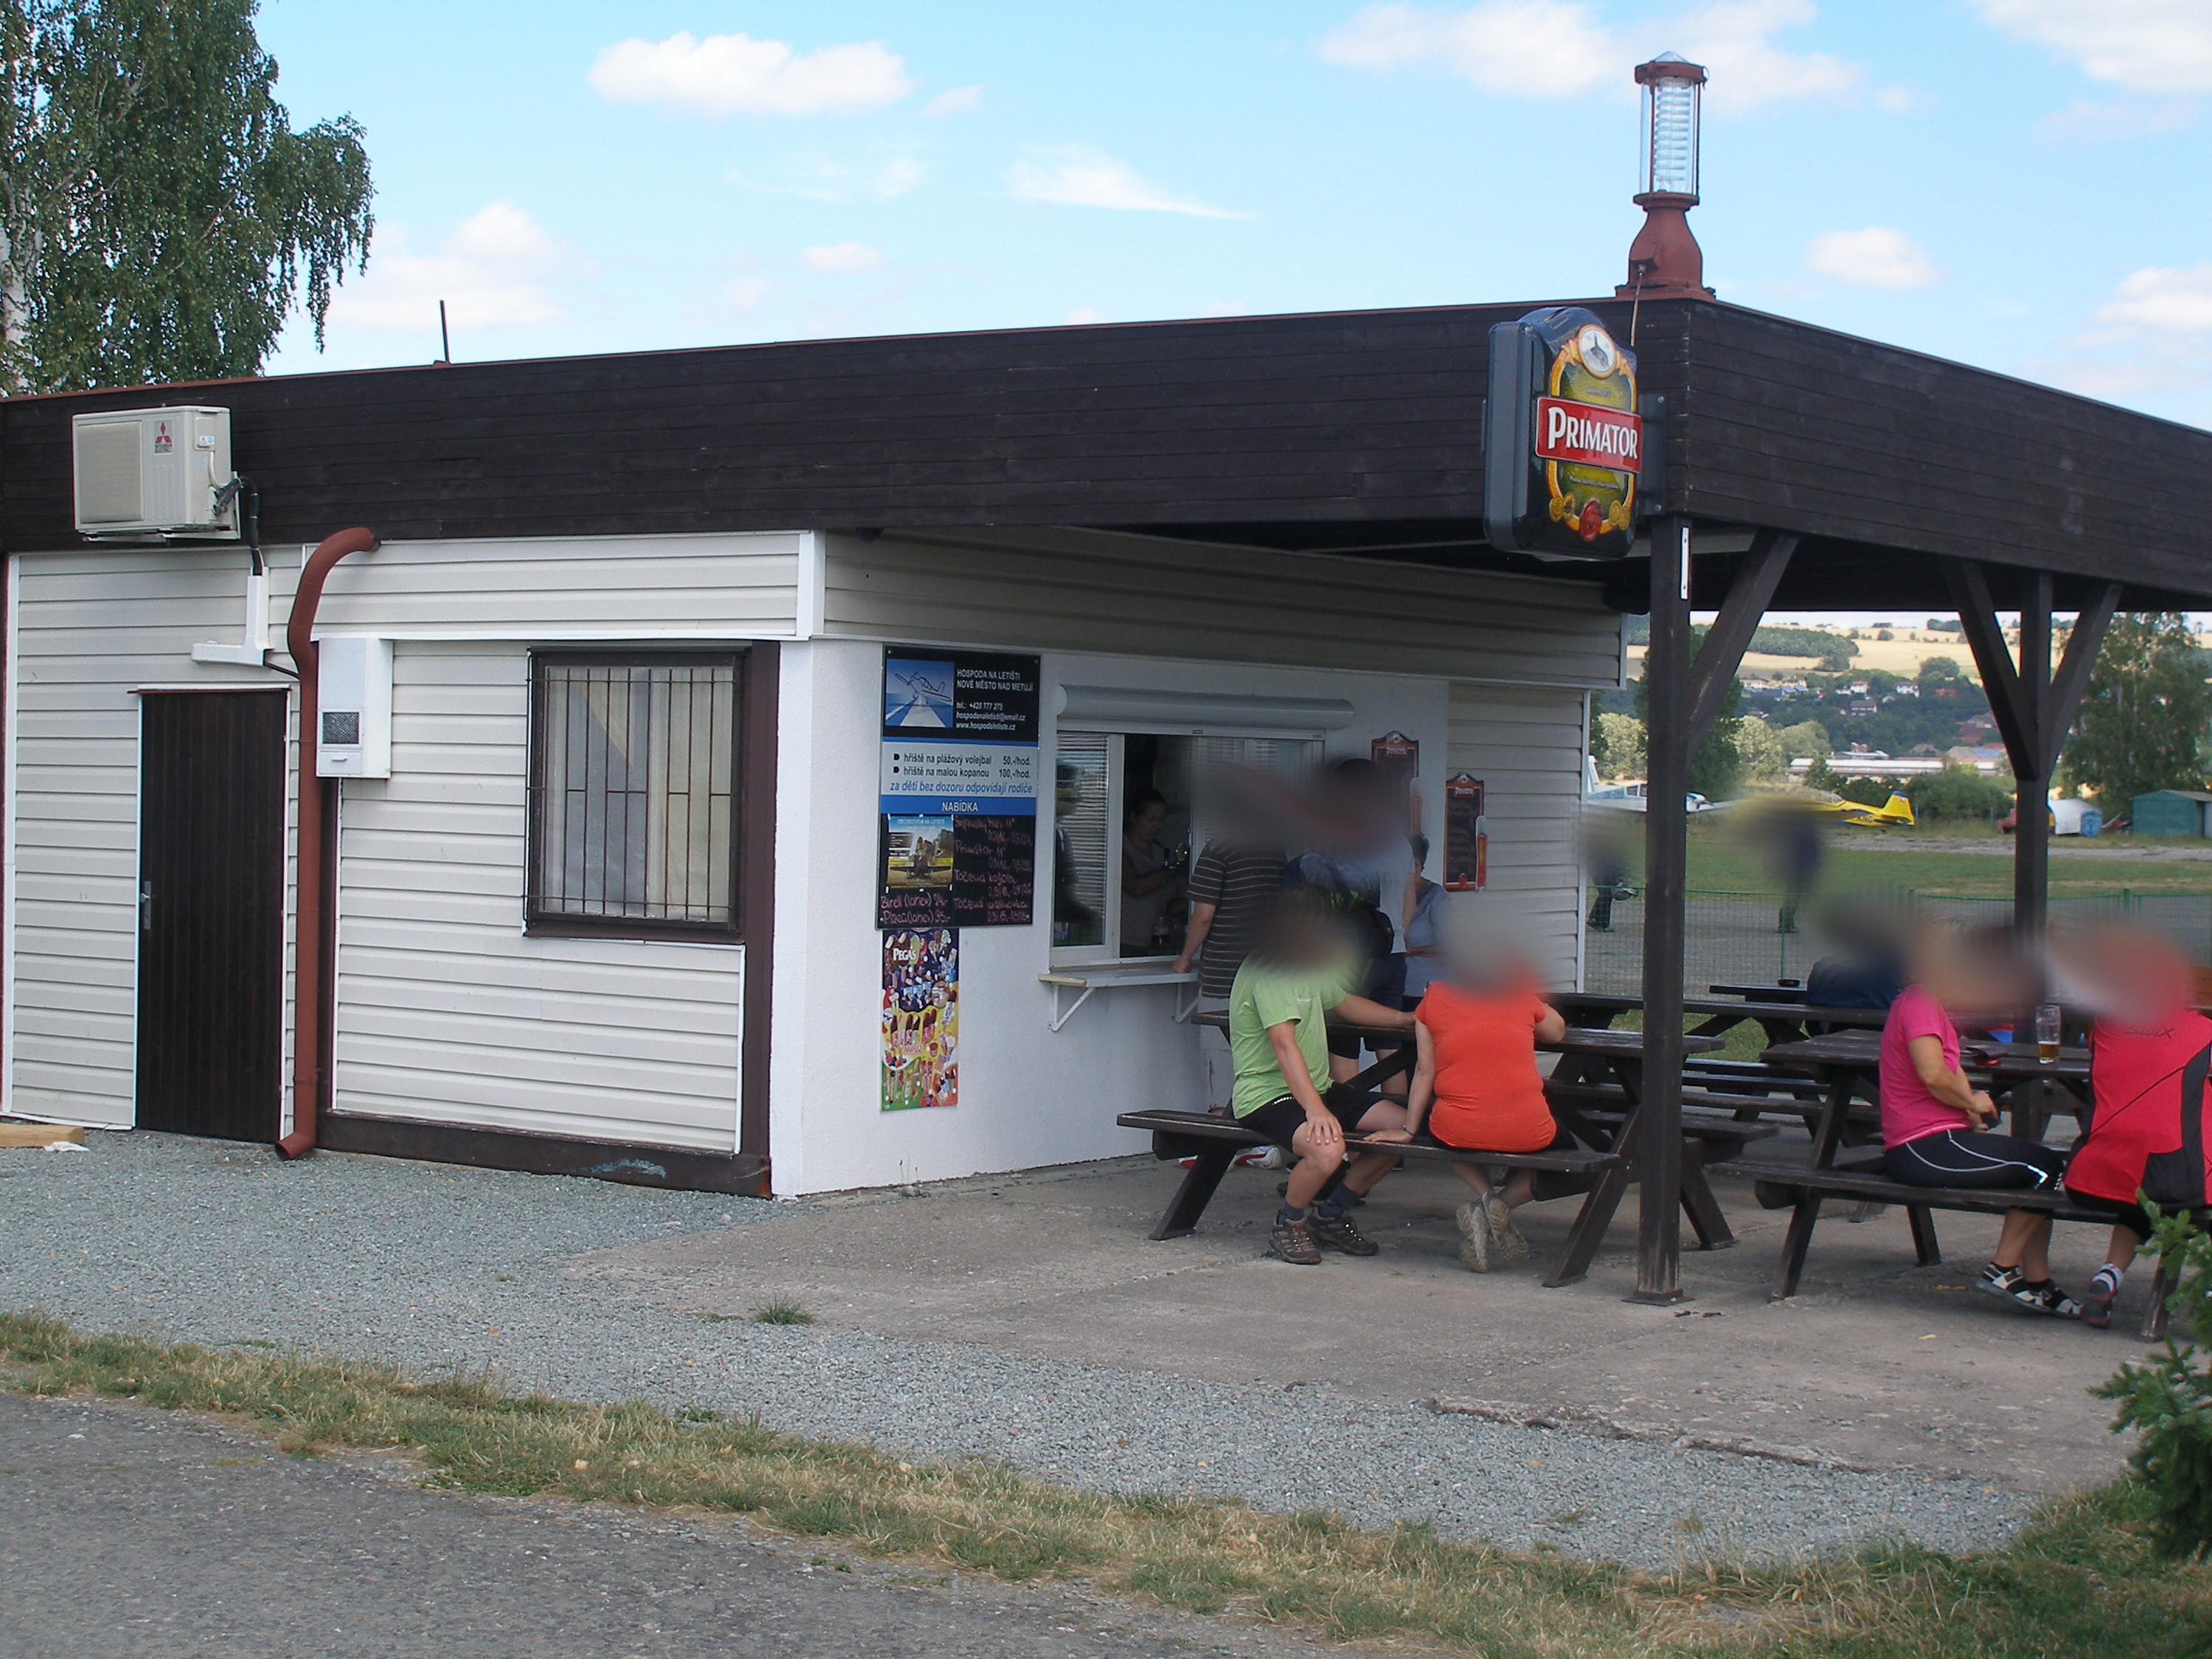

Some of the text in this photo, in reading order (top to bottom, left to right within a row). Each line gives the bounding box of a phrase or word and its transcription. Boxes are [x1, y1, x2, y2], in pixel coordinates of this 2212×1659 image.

[957, 669, 987, 678] HOSPODA
[998, 671, 1020, 680] LETIŠTI
[956, 679, 974, 689] NOVÉ
[975, 680, 996, 689] MĚSTO
[903, 752, 924, 763] hřiště
[925, 755, 935, 763] na
[936, 754, 964, 766] plážový
[965, 755, 992, 766] volejbal
[903, 765, 924, 776] hřiště
[925, 768, 935, 776] na
[936, 768, 959, 777] malou
[959, 768, 990, 779] kopanou
[890, 781, 1033, 796] za děti bez dozoru odpovídají rodiče
[942, 800, 979, 813] NABÍDKA
